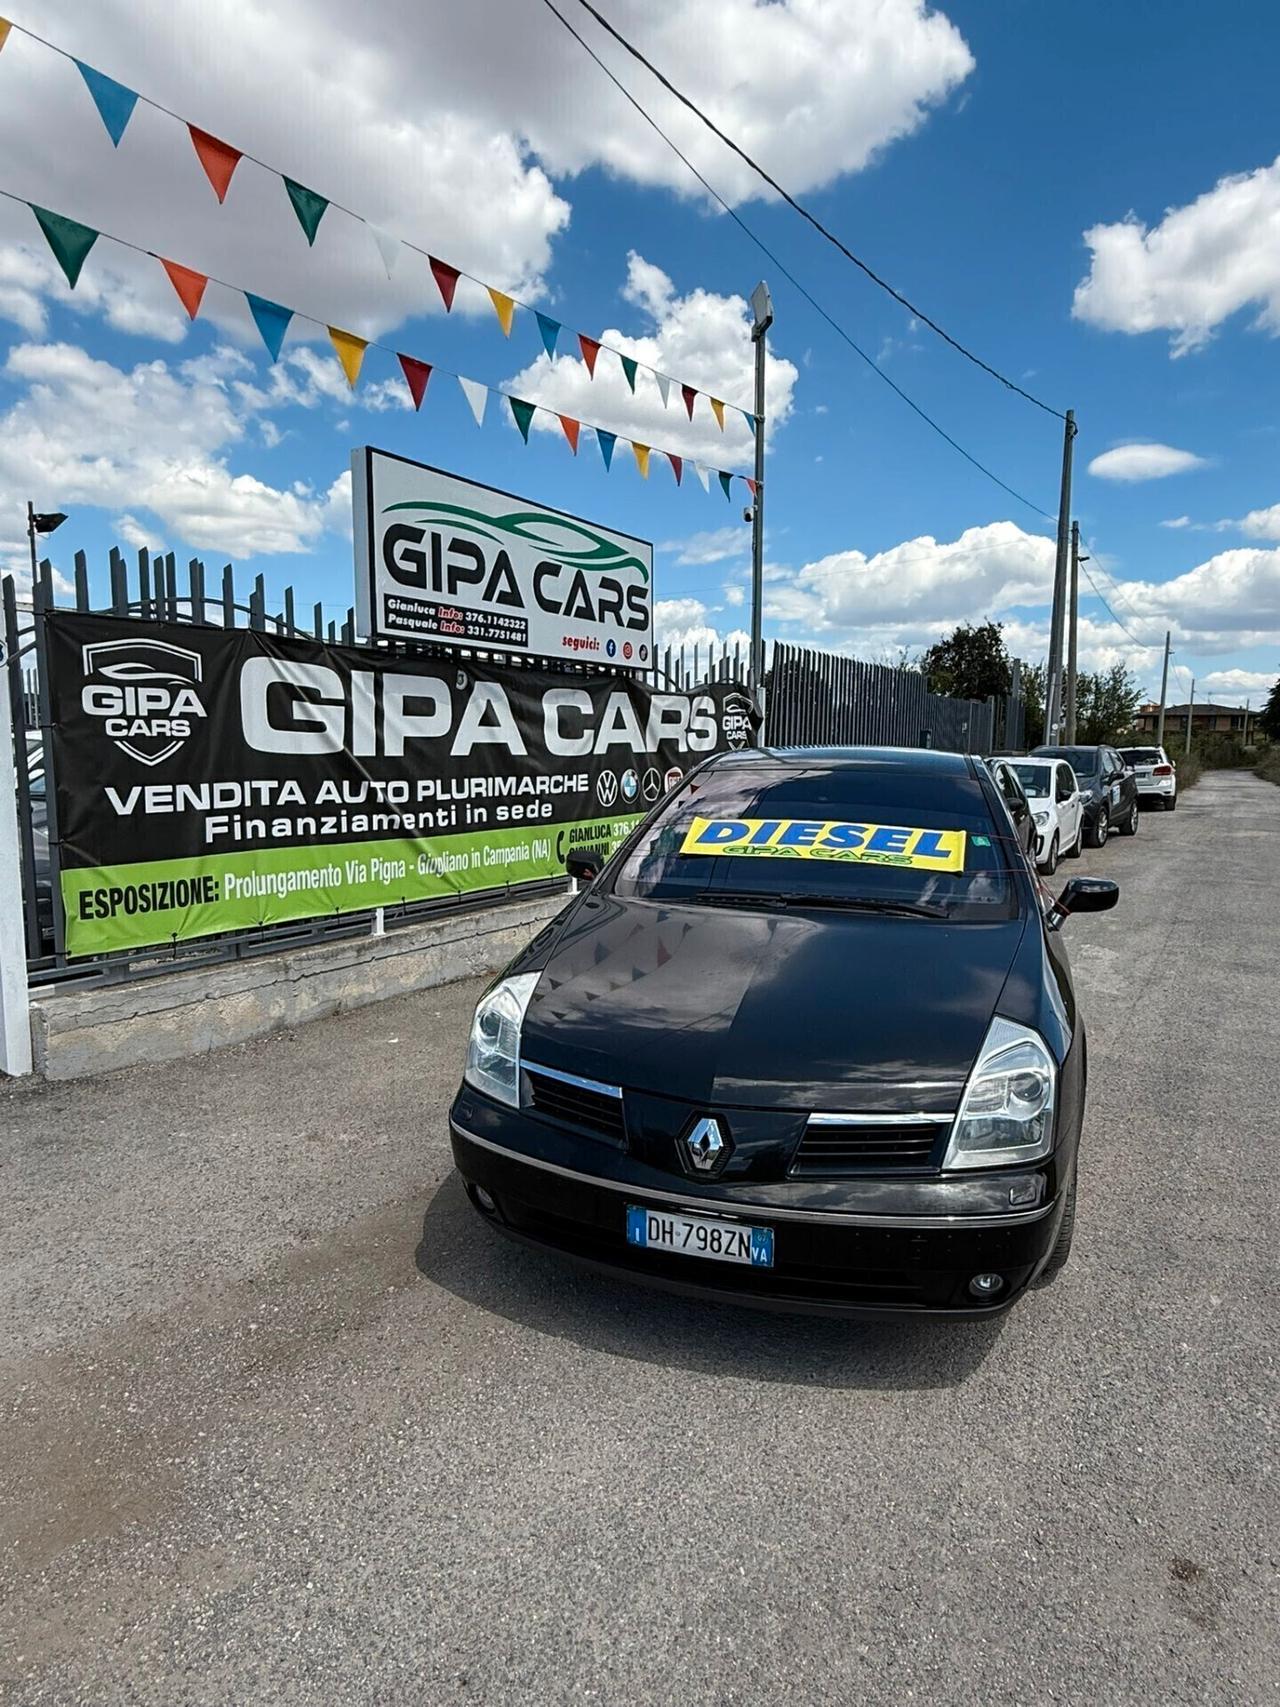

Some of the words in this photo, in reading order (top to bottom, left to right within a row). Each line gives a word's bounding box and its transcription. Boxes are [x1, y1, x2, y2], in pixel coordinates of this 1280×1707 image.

[382, 523, 525, 609] GIPA
[533, 560, 649, 632] CARS
[387, 598, 436, 616] Gianluca
[437, 606, 463, 621] Info:
[465, 611, 526, 630] 376.1142322
[388, 613, 438, 632] Pasquale
[440, 620, 465, 635] Info:
[467, 625, 527, 643] 331.7751481
[562, 634, 600, 652] seguici:
[81, 684, 208, 718] GIPA
[240, 656, 528, 757] GIPA
[542, 688, 718, 757] CARS
[105, 718, 191, 737] CARS
[722, 715, 752, 731] GIPA
[726, 731, 747, 740] CARS
[104, 780, 307, 816] VENDITA
[315, 780, 410, 805] AUTO
[417, 773, 590, 802] PLURIMARCHE
[205, 805, 457, 843] Finanziamenti
[466, 803, 488, 825] in
[496, 799, 553, 821] sede
[569, 824, 612, 843] GIANLUCA
[695, 822, 953, 858] DIESEL
[722, 845, 802, 857] GIPA
[809, 847, 913, 865] CARS
[79, 875, 220, 920] ESPOSIZIONE:
[223, 863, 342, 900] Prolungamento
[345, 856, 367, 884] Via
[371, 853, 406, 886] Pigna
[417, 846, 469, 879] Giugliano
[471, 847, 481, 866] in
[483, 839, 530, 867] Campania
[531, 837, 552, 861] (NA)
[752, 1247, 768, 1263] VA
